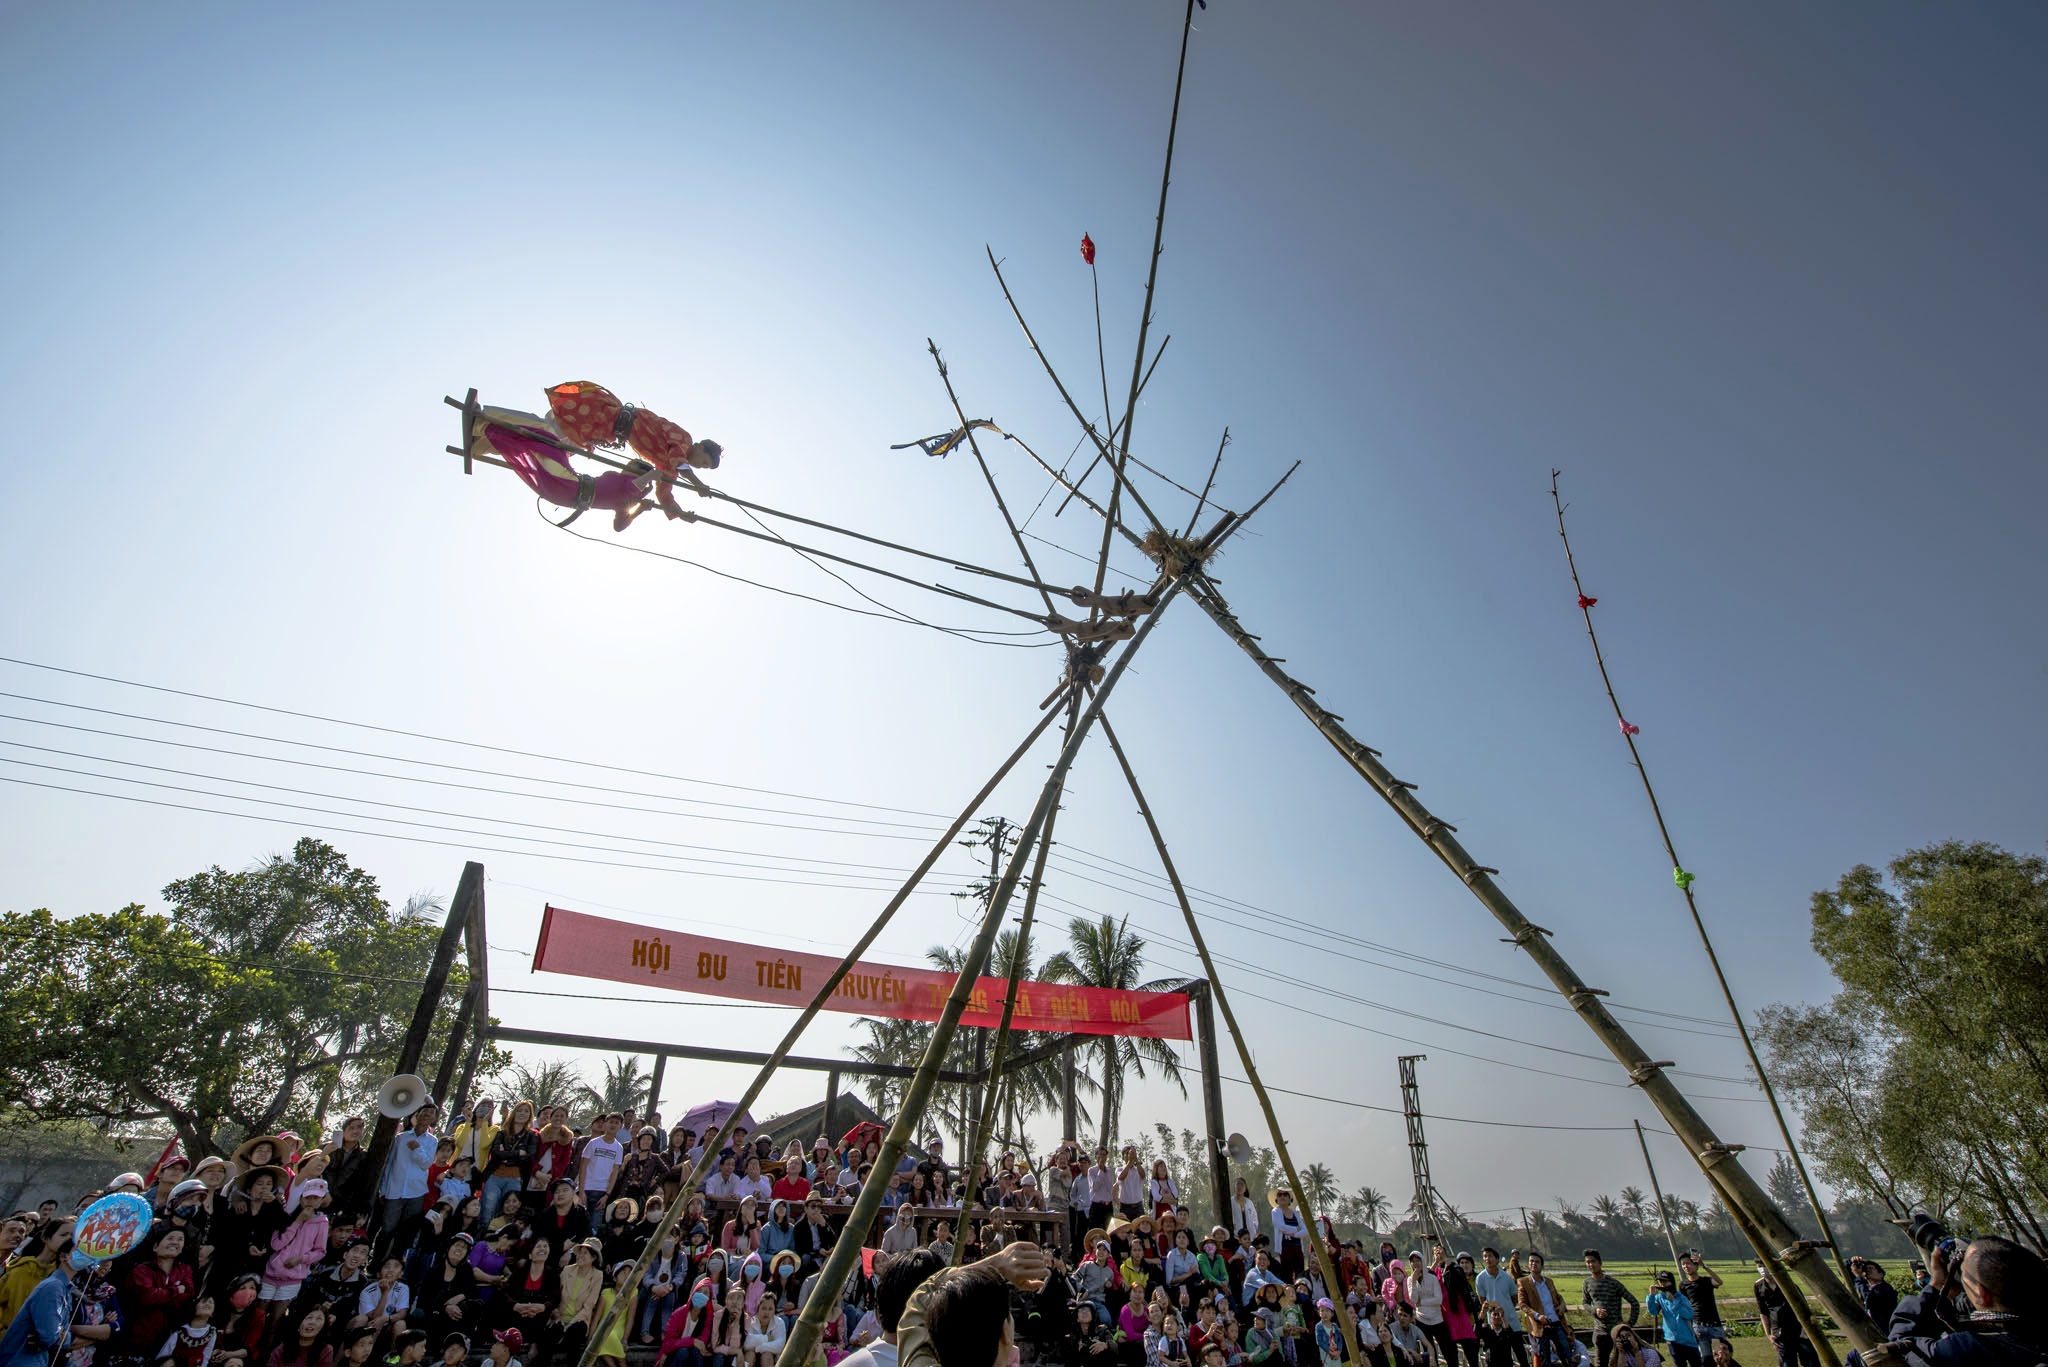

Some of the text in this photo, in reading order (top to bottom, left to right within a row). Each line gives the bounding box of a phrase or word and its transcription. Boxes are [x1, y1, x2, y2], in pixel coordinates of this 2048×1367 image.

[632, 937, 671, 974] HỘI
[697, 952, 728, 981] ĐU
[755, 958, 801, 991] TIÊN
[832, 970, 906, 1003] RUYỀN
